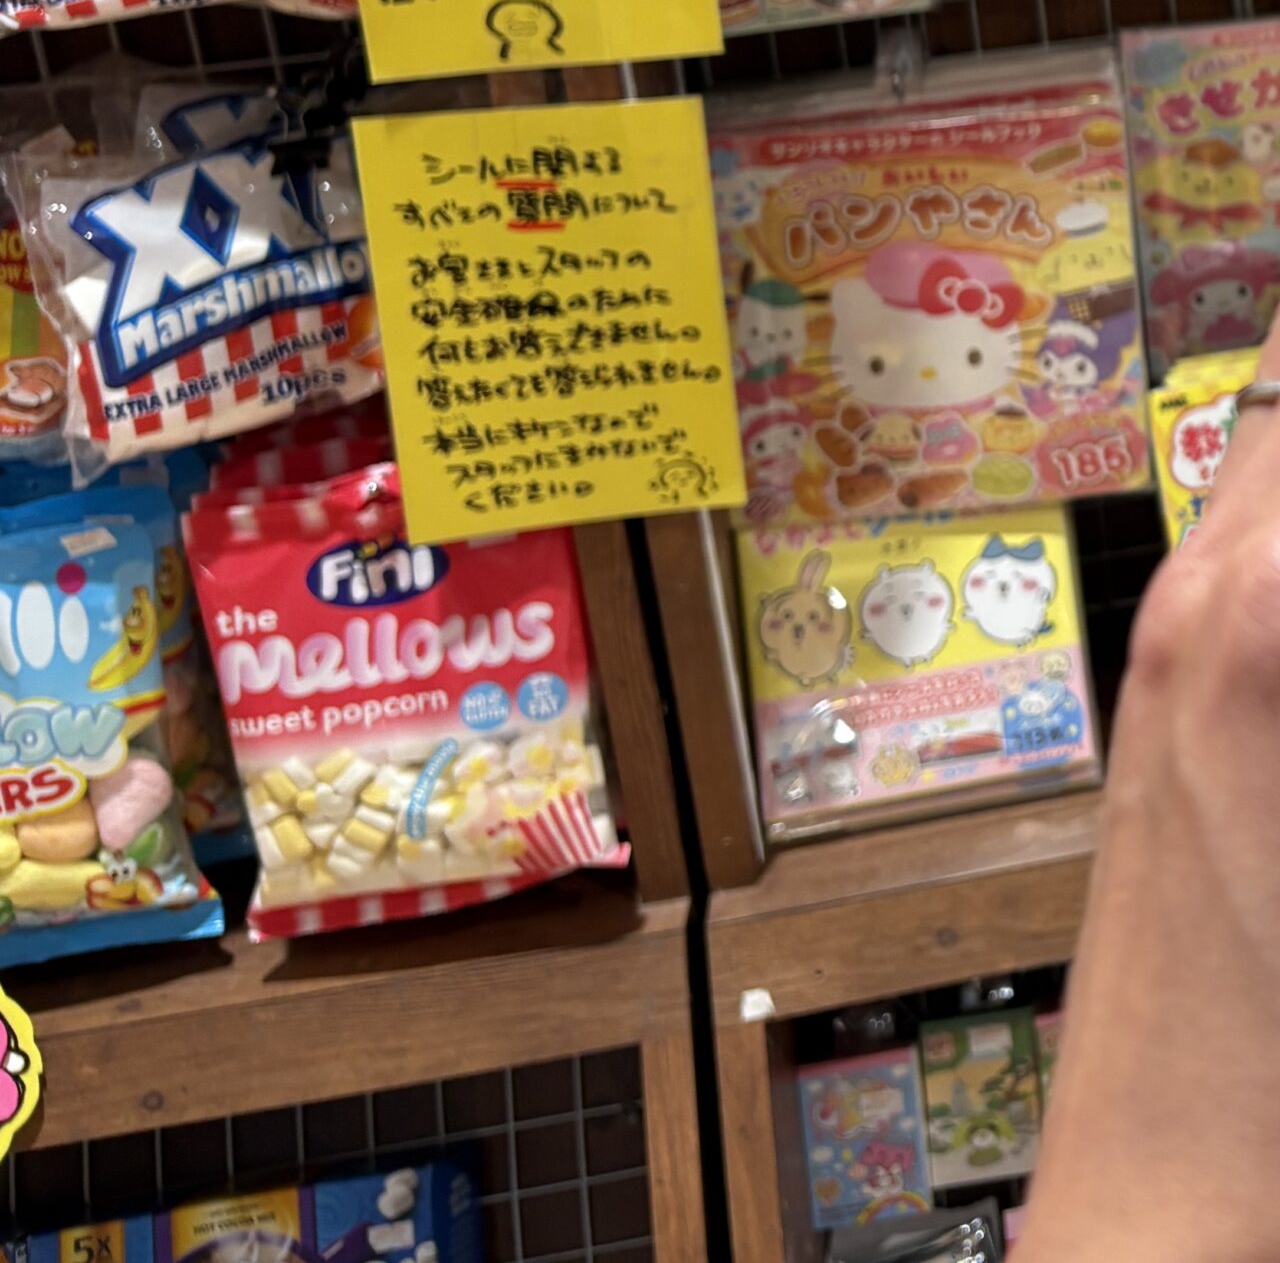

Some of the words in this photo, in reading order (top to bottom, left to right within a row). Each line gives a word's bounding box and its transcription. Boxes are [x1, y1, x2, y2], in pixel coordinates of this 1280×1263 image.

[420, 146, 623, 184] シールに関する
[785, 183, 1052, 268] パンやさん
[406, 244, 652, 289] お客さまとスタッフの
[409, 287, 673, 329] 安全確保のために
[417, 320, 702, 367] 何もお答えできません。
[104, 393, 163, 423] EXTRA
[166, 372, 220, 405] LARGE
[223, 321, 347, 383] MARSHMALLOW
[261, 368, 347, 405] 10pcs
[416, 360, 723, 412] 答えたくても答えられません。
[446, 428, 688, 489] スタッフにきかないで
[1052, 438, 1132, 486] 185
[464, 479, 595, 513] ください。
[317, 544, 437, 604] Fini
[215, 605, 280, 638] the
[230, 697, 316, 738] sweet
[322, 686, 449, 735] popcorn
